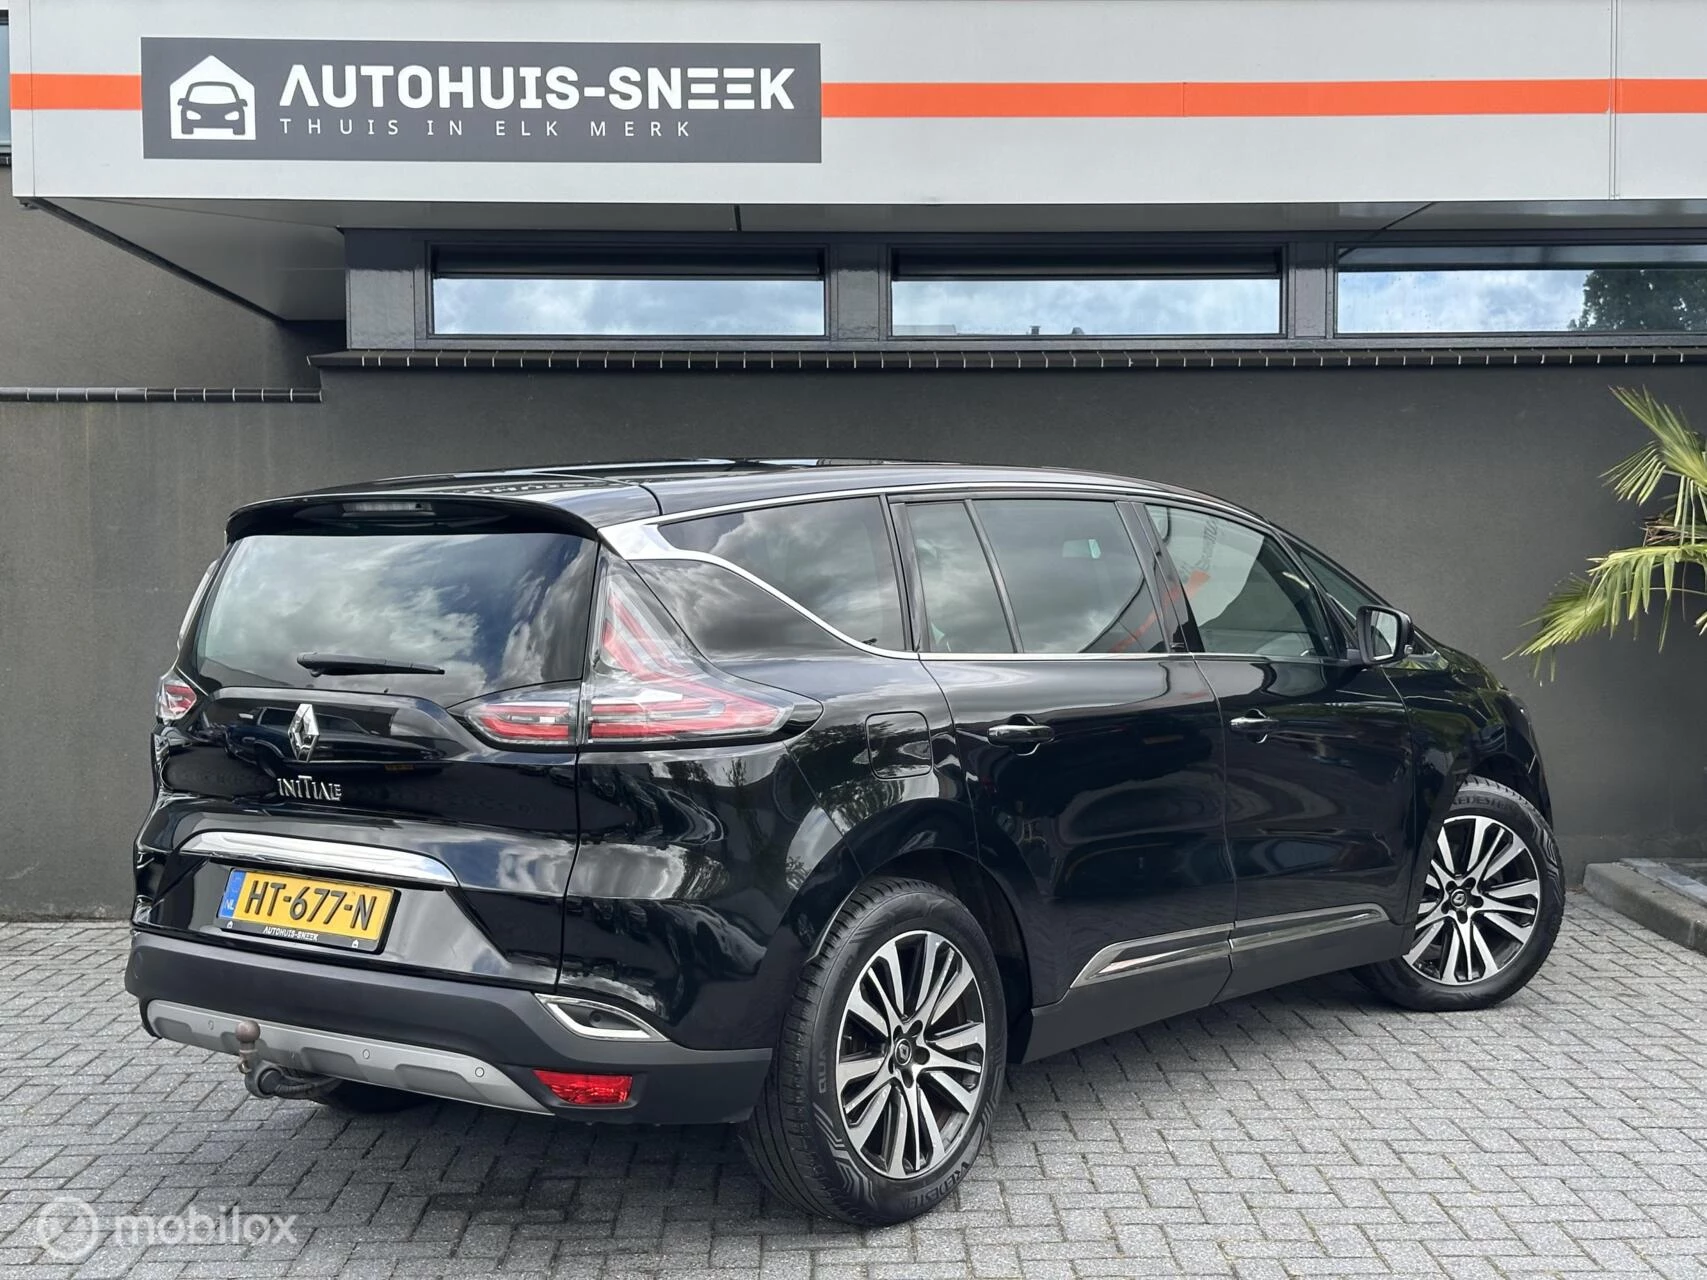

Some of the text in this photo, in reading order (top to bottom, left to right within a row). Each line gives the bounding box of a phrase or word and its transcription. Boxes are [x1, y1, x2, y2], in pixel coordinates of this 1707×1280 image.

[279, 64, 795, 110] AUTOHUIS-SNEEK
[279, 118, 689, 137] THUIS IN ELK MERK
[277, 775, 342, 801] INITIALE
[244, 879, 377, 931] HT-677-N
[262, 926, 319, 942] AUTOHUIS-SNEEK
